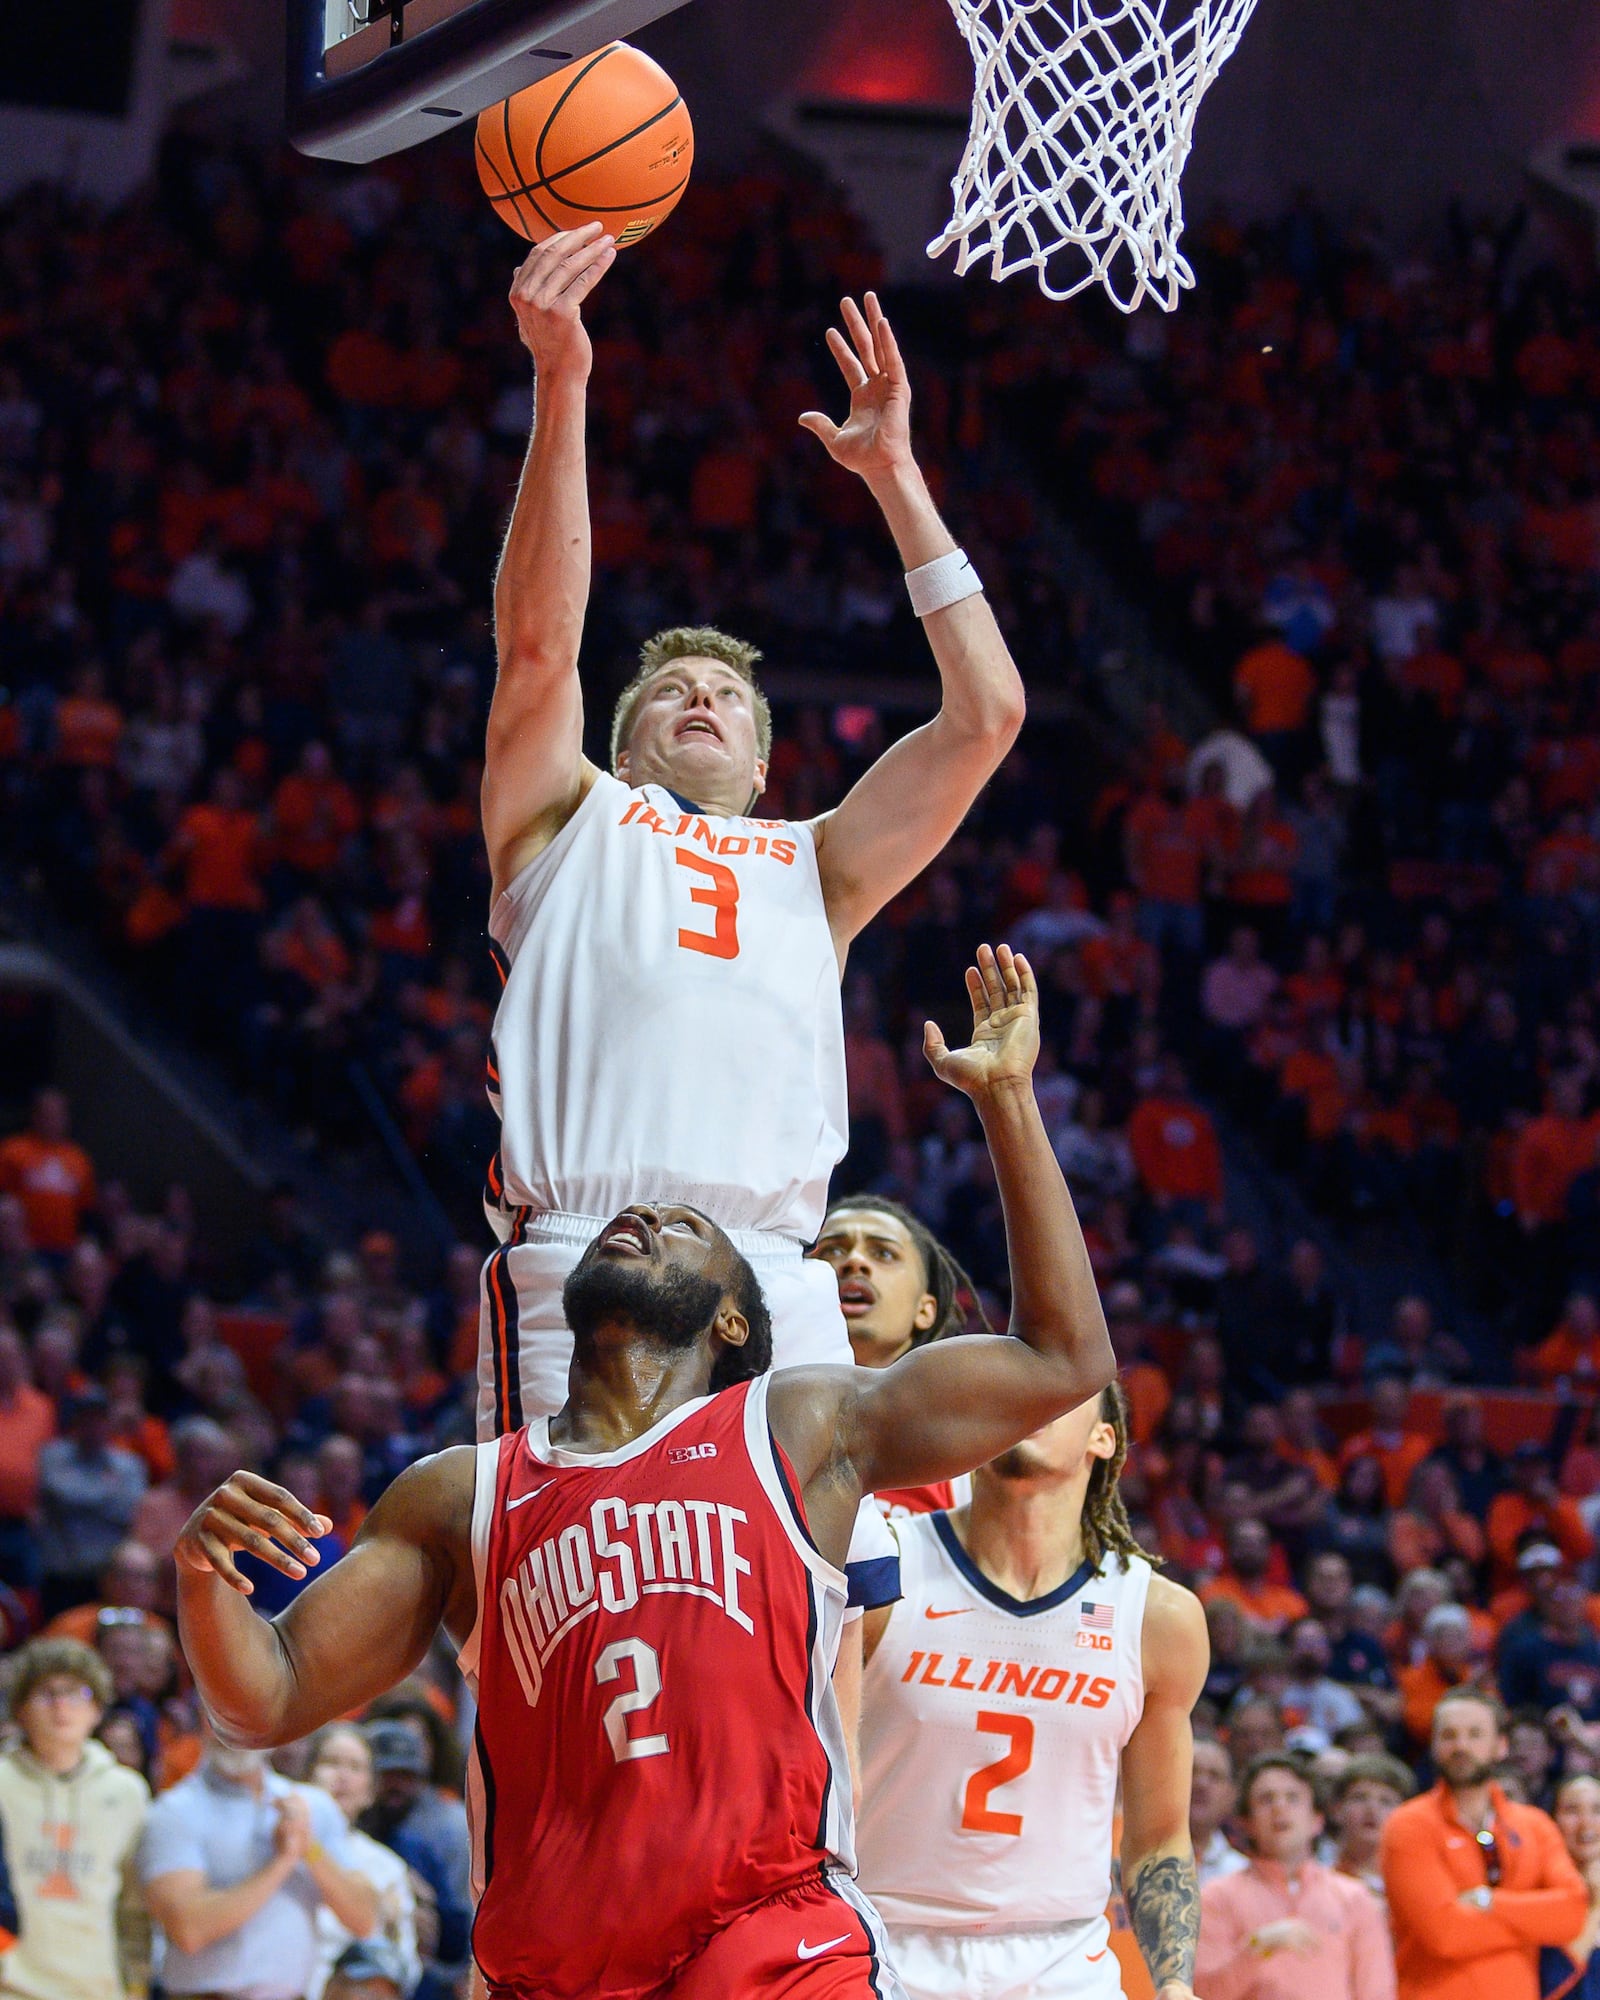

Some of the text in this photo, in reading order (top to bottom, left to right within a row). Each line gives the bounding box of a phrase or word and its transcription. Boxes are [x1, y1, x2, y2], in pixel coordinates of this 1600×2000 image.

[618, 801, 797, 866] ILLINOIS
[675, 847, 740, 960] 3
[500, 1497, 754, 1708] OHIO STATE
[594, 1636, 670, 1763] 2
[901, 1651, 1117, 1709] ILLINOIS
[961, 1710, 1035, 1836] 2
